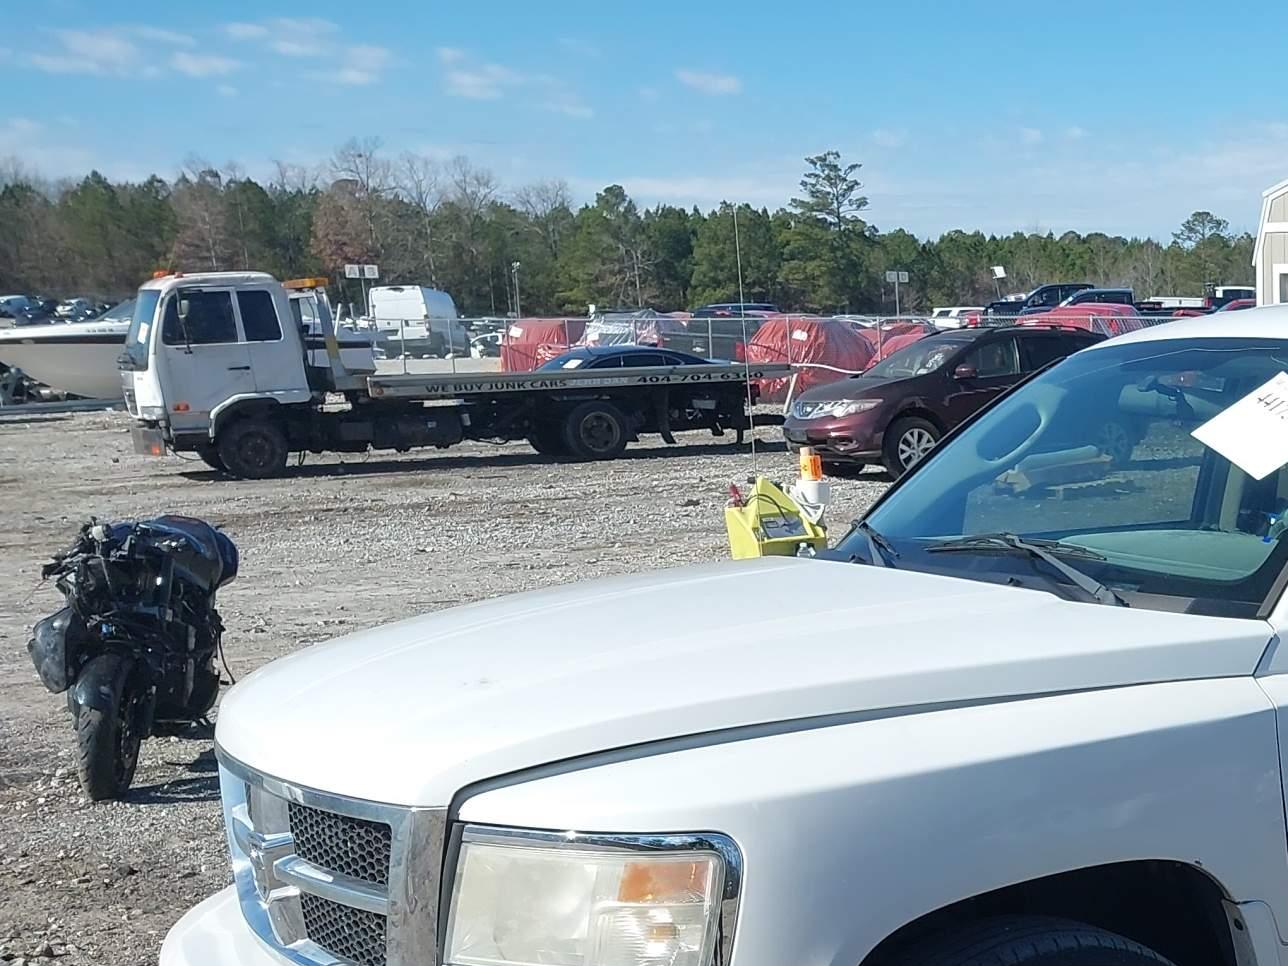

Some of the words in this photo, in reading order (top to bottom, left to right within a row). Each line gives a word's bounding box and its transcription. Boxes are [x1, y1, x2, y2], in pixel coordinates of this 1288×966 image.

[425, 385, 449, 393] WE
[454, 383, 484, 392] BUY
[488, 381, 526, 391] JUNK
[530, 379, 567, 388] CARS
